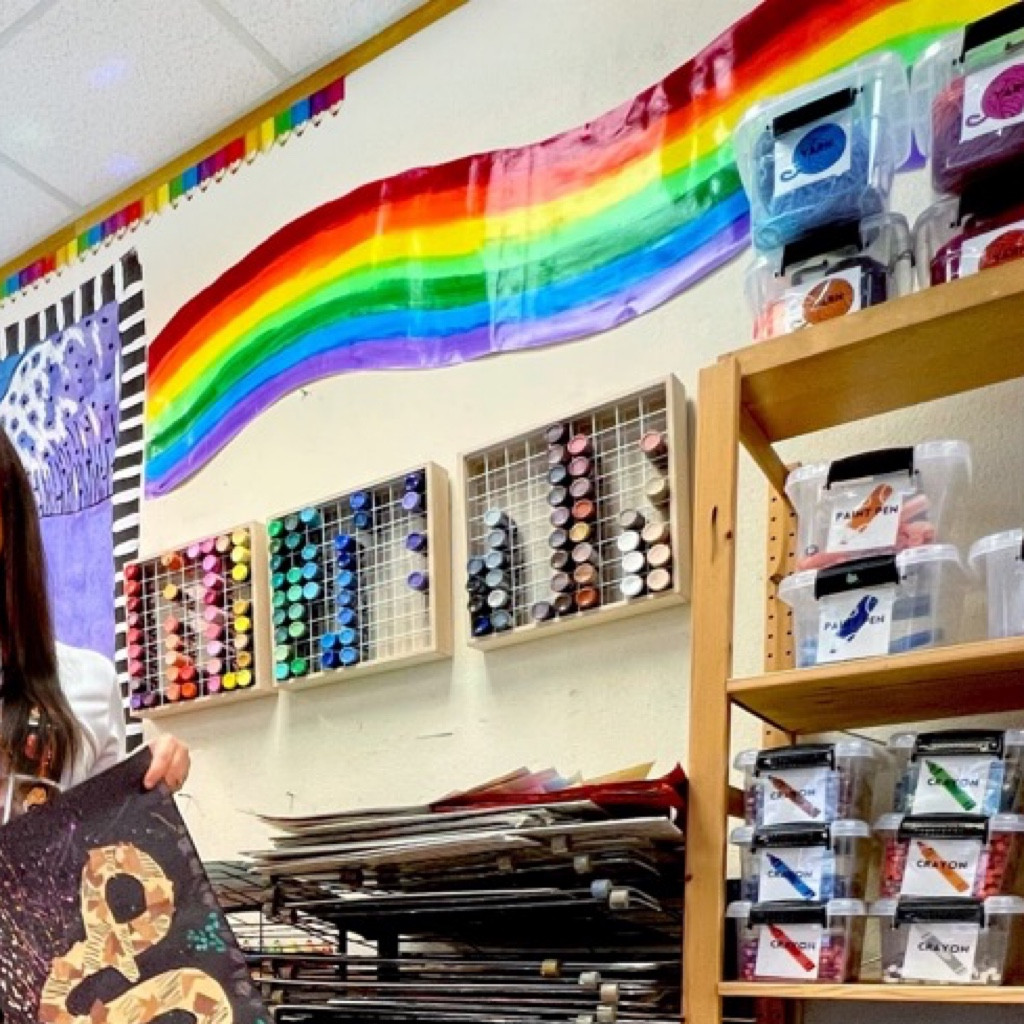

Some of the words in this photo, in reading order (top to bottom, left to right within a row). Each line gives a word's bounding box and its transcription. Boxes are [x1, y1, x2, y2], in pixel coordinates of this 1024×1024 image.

[835, 507, 871, 521] PAINT
[875, 504, 899, 517] PEN
[927, 778, 979, 786] CRON
[769, 788, 816, 801] CRON
[916, 860, 968, 870] CRAYON
[767, 870, 813, 879] CRON
[769, 939, 816, 950] CRON
[917, 941, 971, 954] CRAYON
